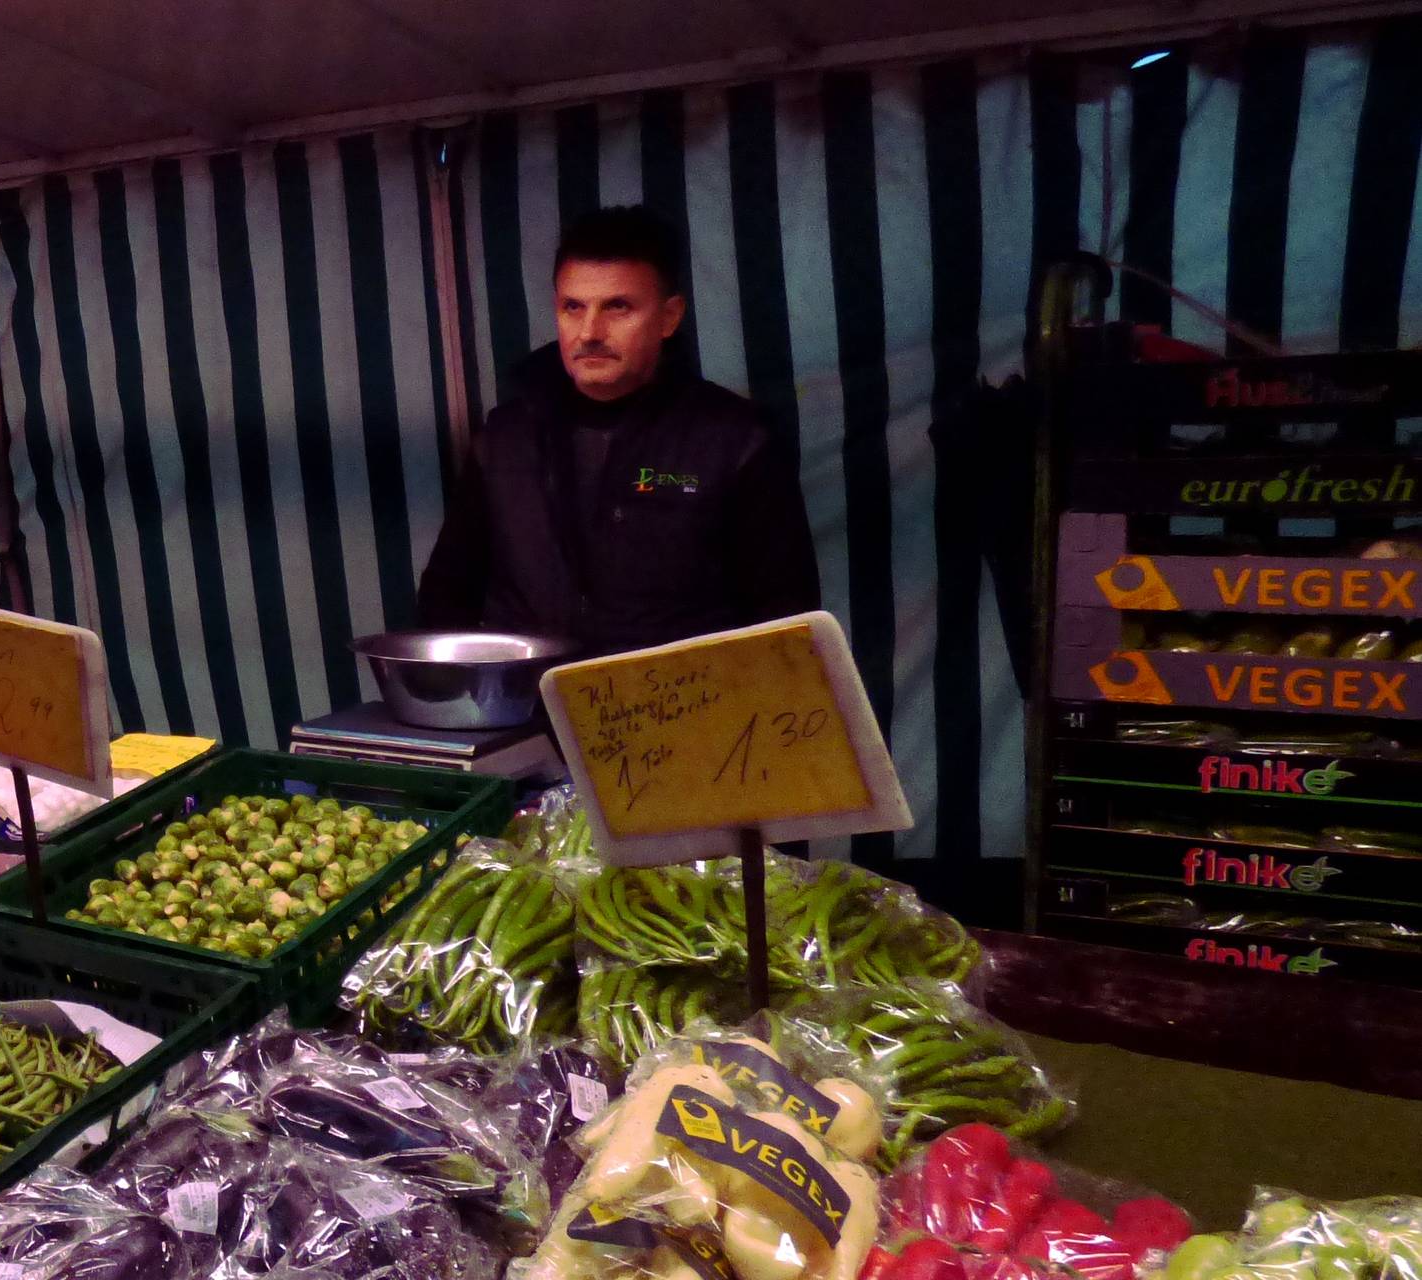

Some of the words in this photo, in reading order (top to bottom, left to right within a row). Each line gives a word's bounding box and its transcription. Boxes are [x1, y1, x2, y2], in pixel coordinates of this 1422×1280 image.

[1211, 566, 1418, 610] VEGEX
[1205, 664, 1408, 712] VEGEX
[730, 1128, 843, 1226] VEGEX
